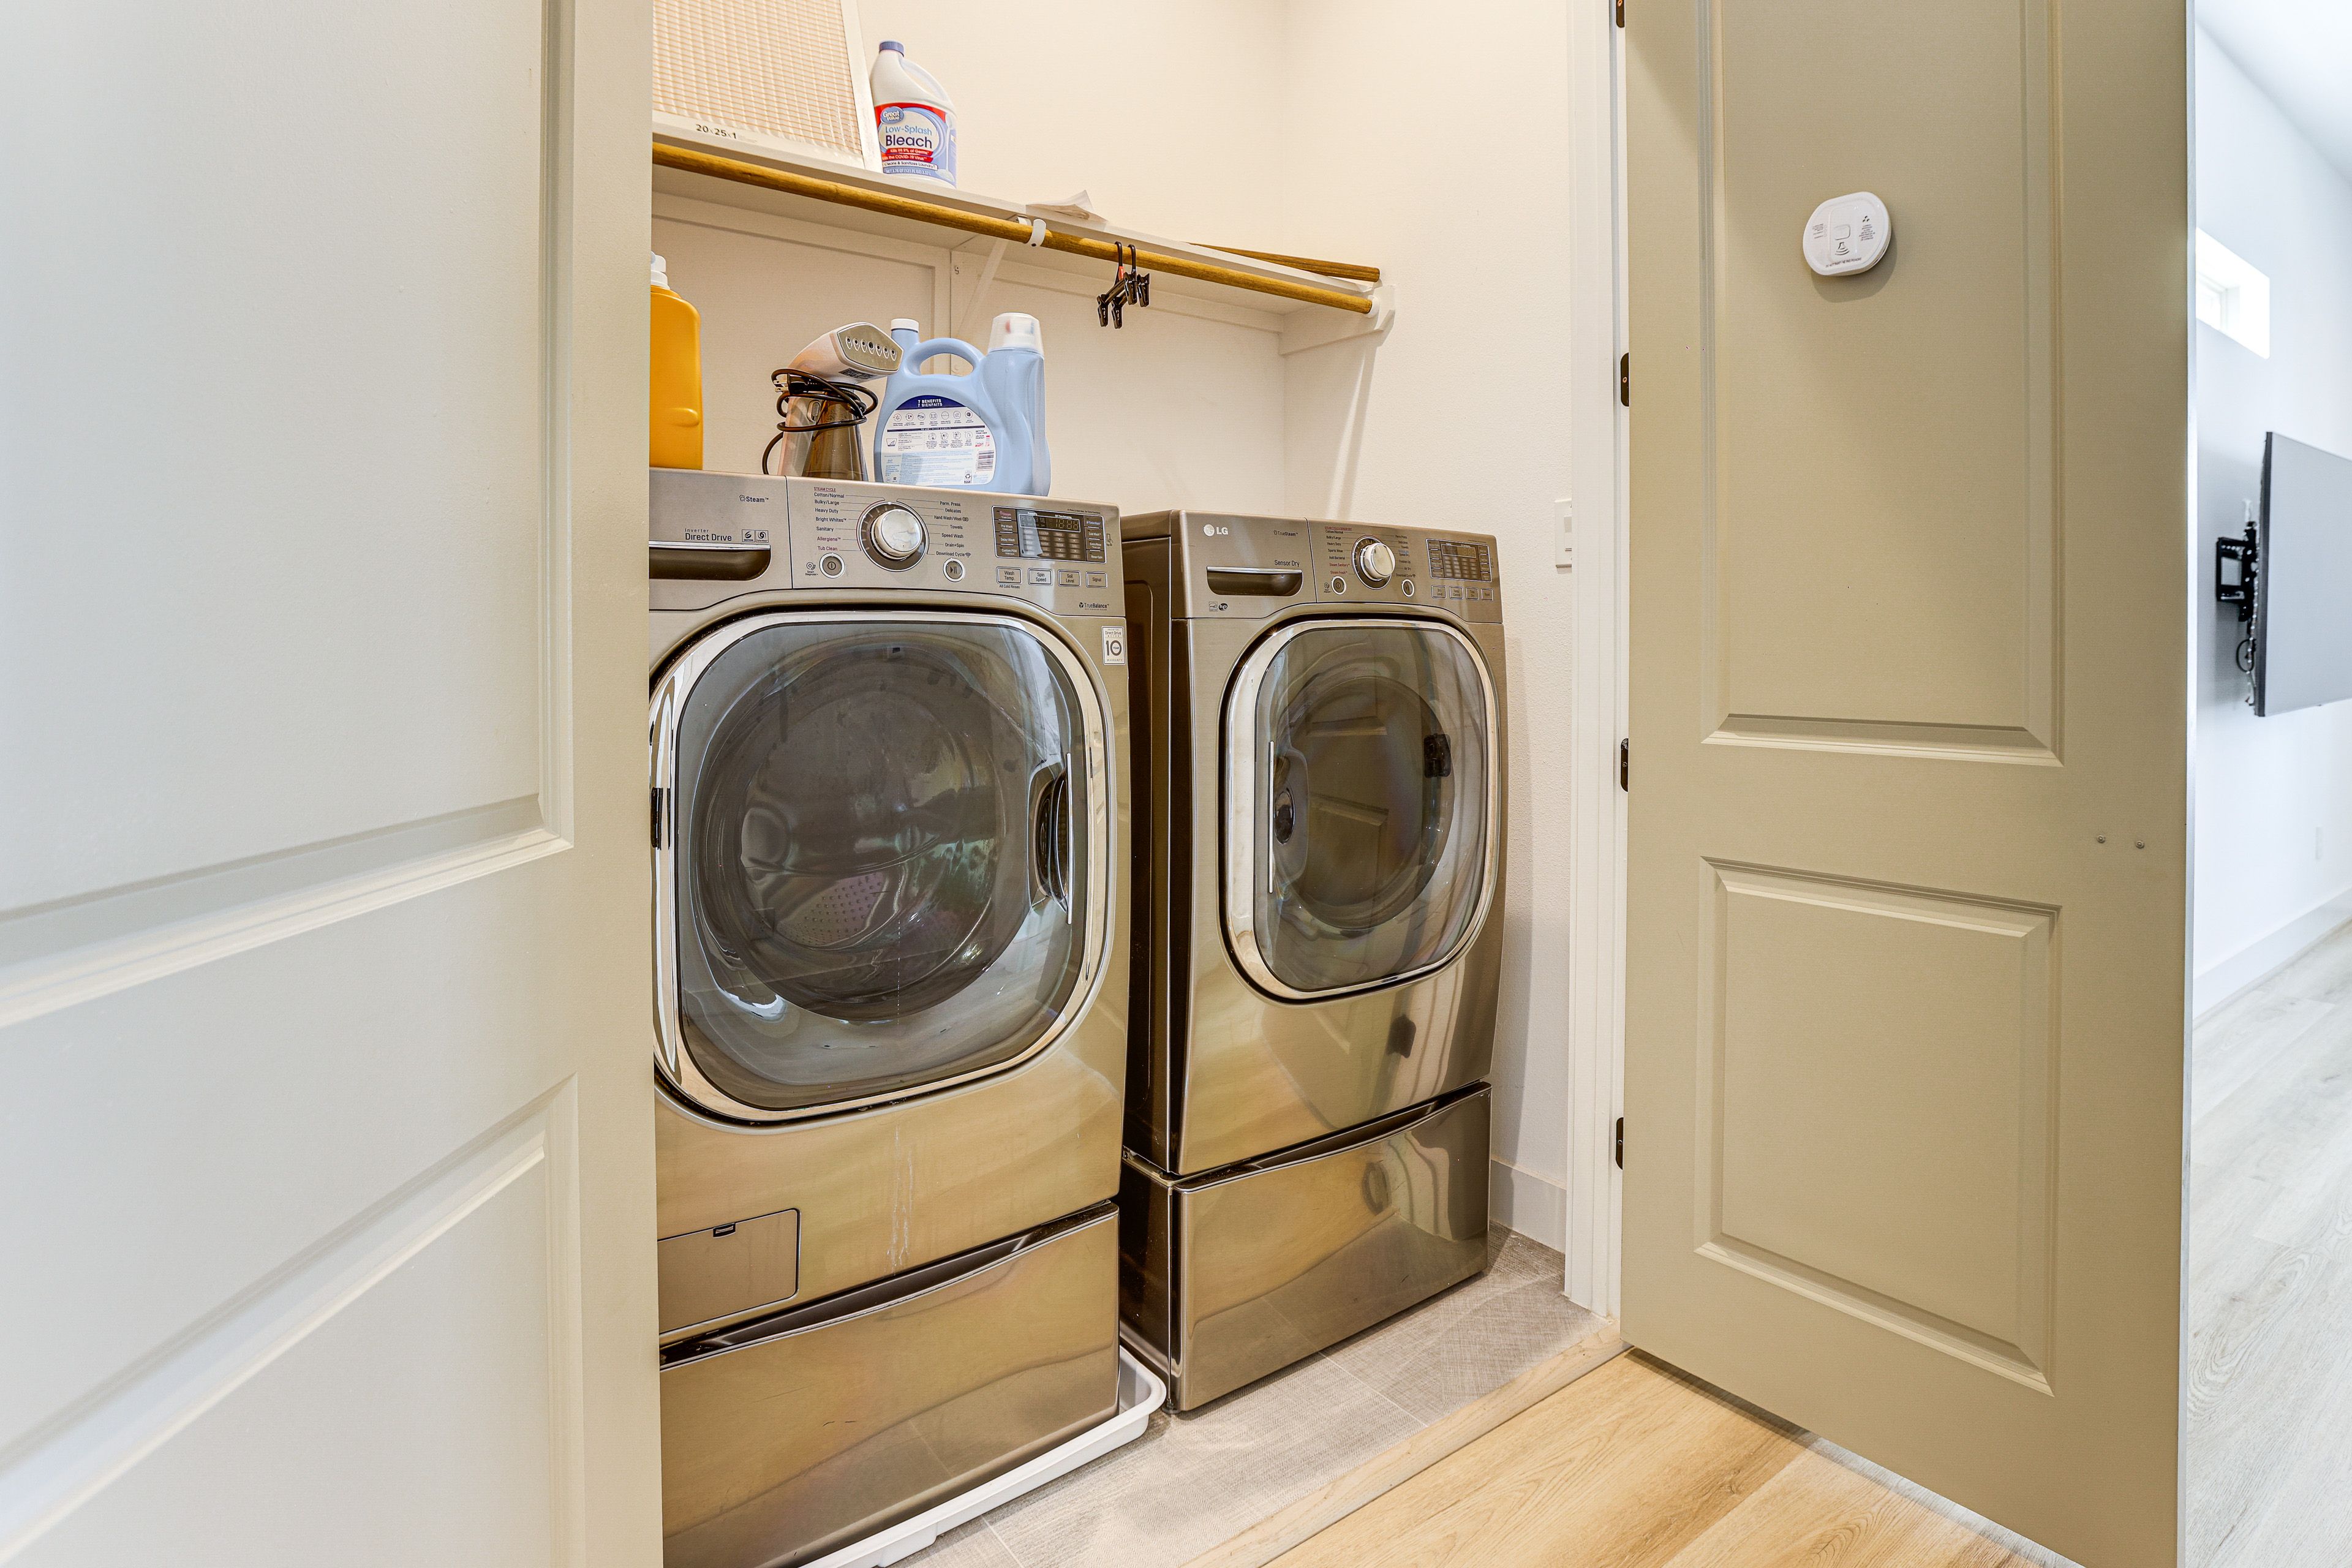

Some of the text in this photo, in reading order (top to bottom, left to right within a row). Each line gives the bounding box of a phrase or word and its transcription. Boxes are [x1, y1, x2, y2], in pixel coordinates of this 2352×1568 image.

[885, 125, 932, 135] Low-Splash
[886, 134, 932, 148] Bleach
[1216, 527, 1229, 535] LG
[1106, 640, 1122, 656] 10
